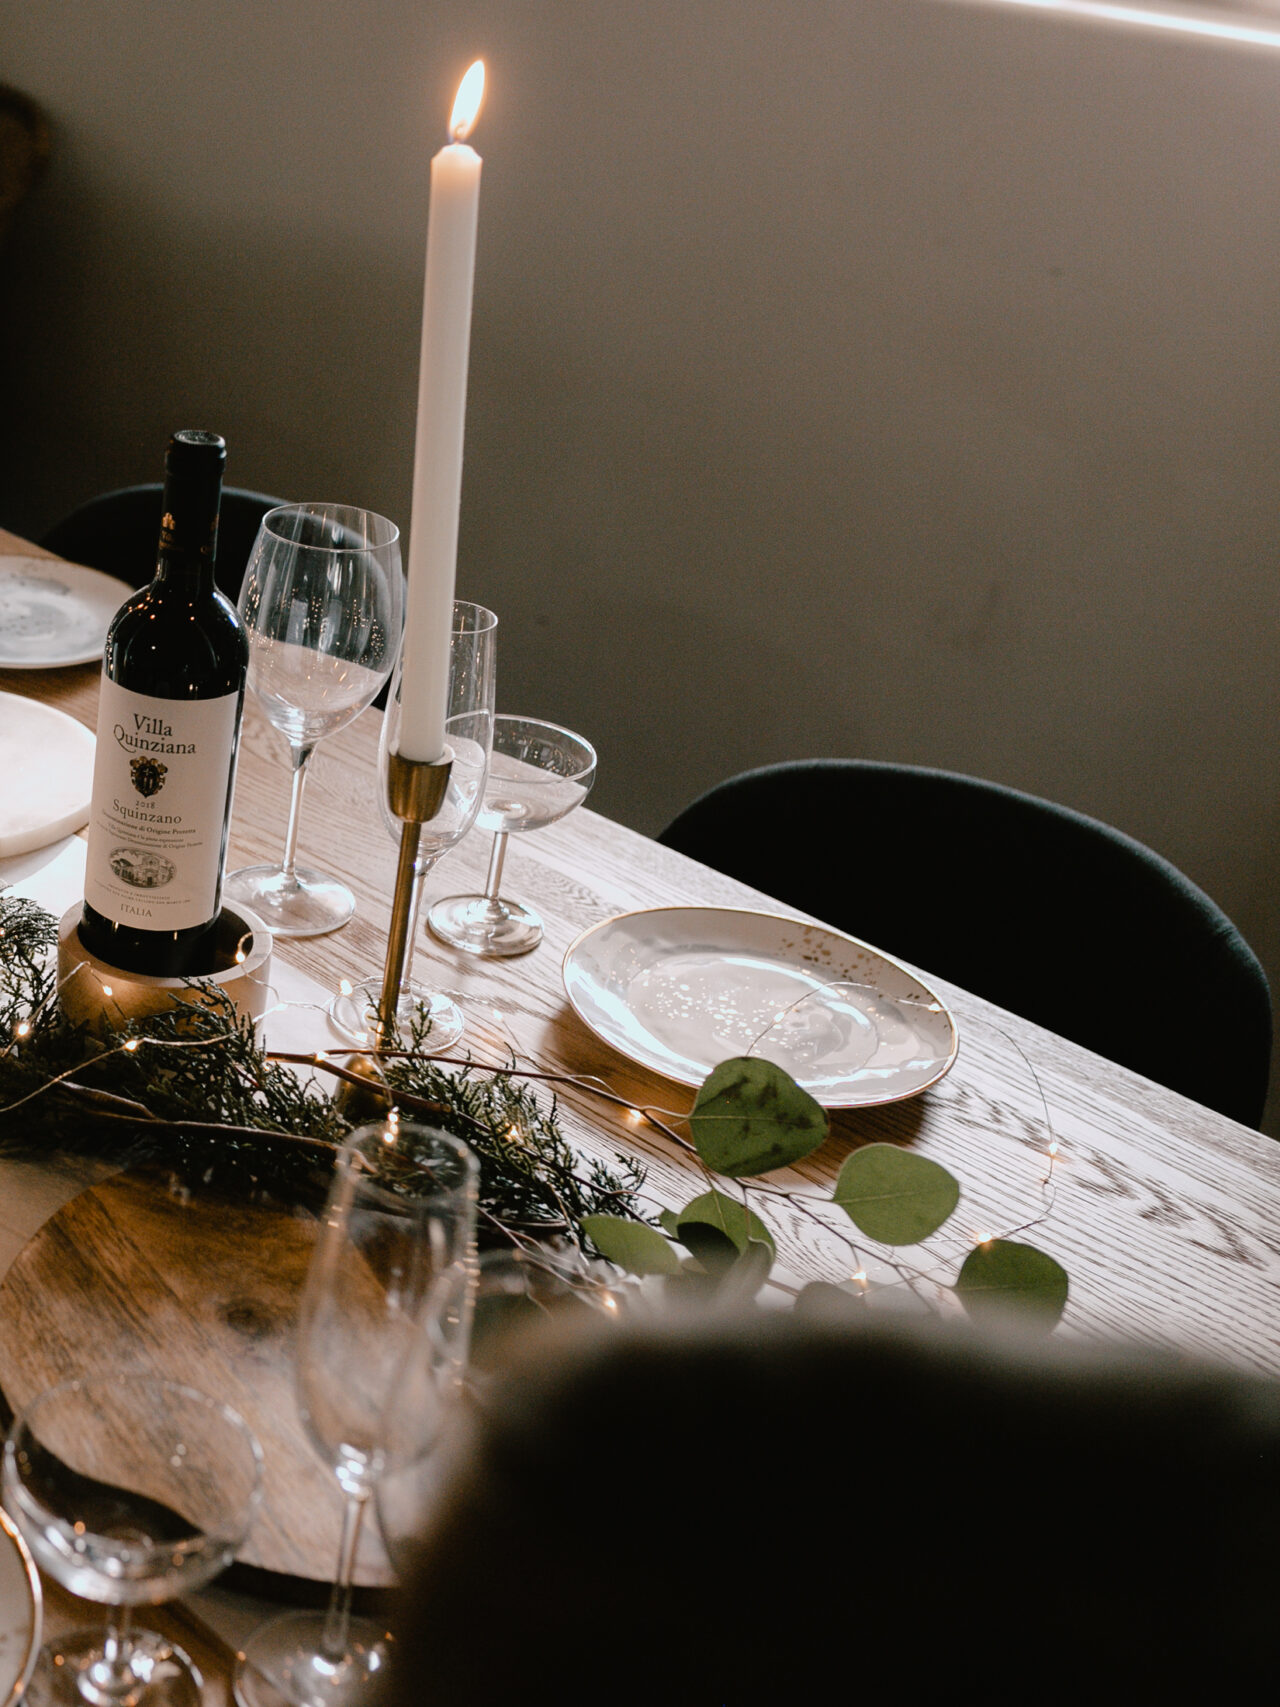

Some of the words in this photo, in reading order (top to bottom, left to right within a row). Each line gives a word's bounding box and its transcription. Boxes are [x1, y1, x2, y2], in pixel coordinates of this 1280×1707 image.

[133, 713, 173, 737] Villa
[113, 724, 196, 754] Quinziana
[112, 798, 182, 824] Squinzano
[135, 800, 156, 810] 2018
[146, 826, 170, 835] Origine
[120, 903, 152, 917] ITALIA
